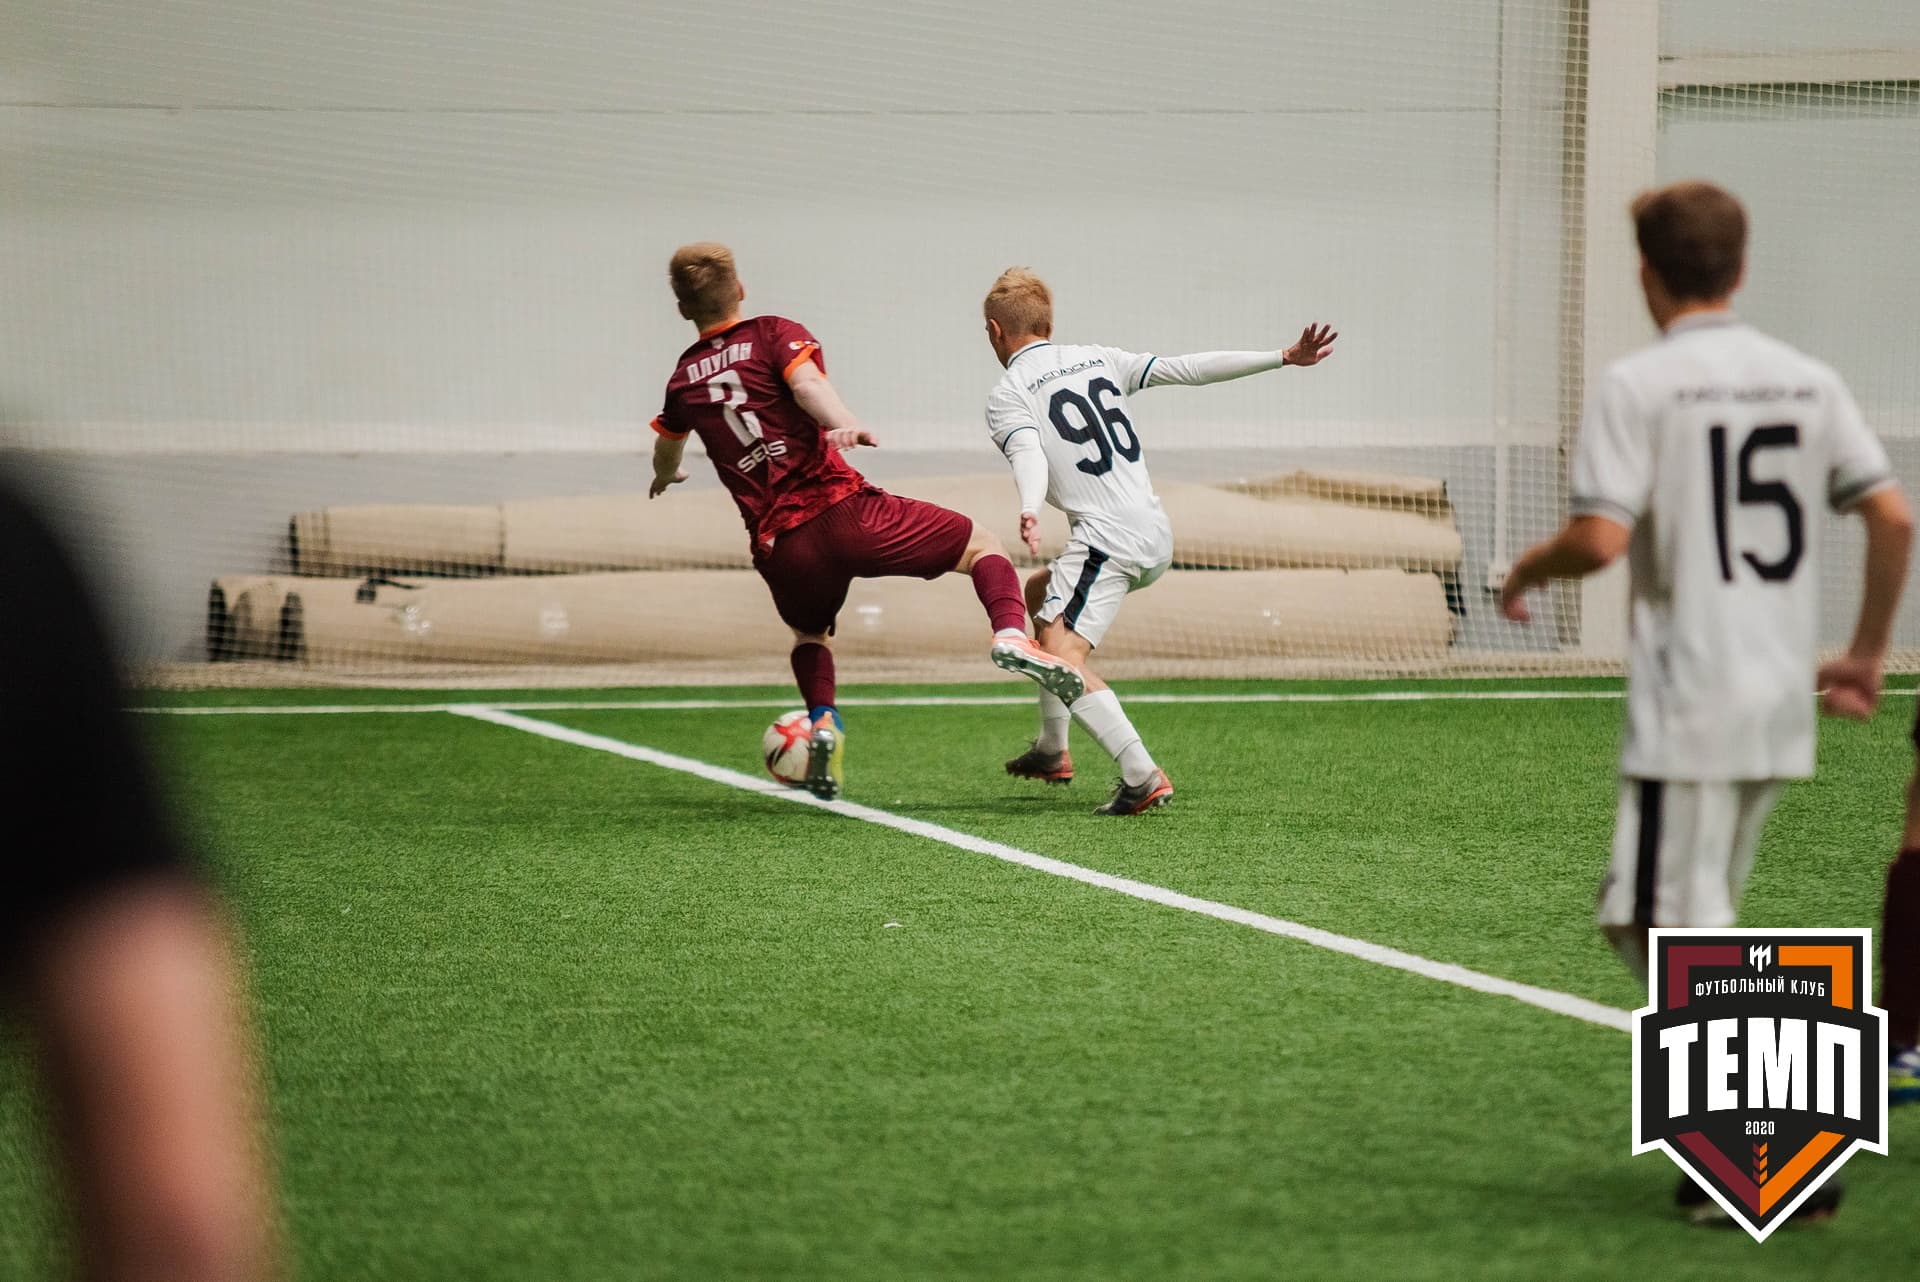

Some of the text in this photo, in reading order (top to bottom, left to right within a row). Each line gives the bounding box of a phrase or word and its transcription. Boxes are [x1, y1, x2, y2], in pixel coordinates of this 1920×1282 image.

[707, 369, 764, 447] 2
[1048, 376, 1141, 477] 96
[1709, 424, 1806, 582] 15
